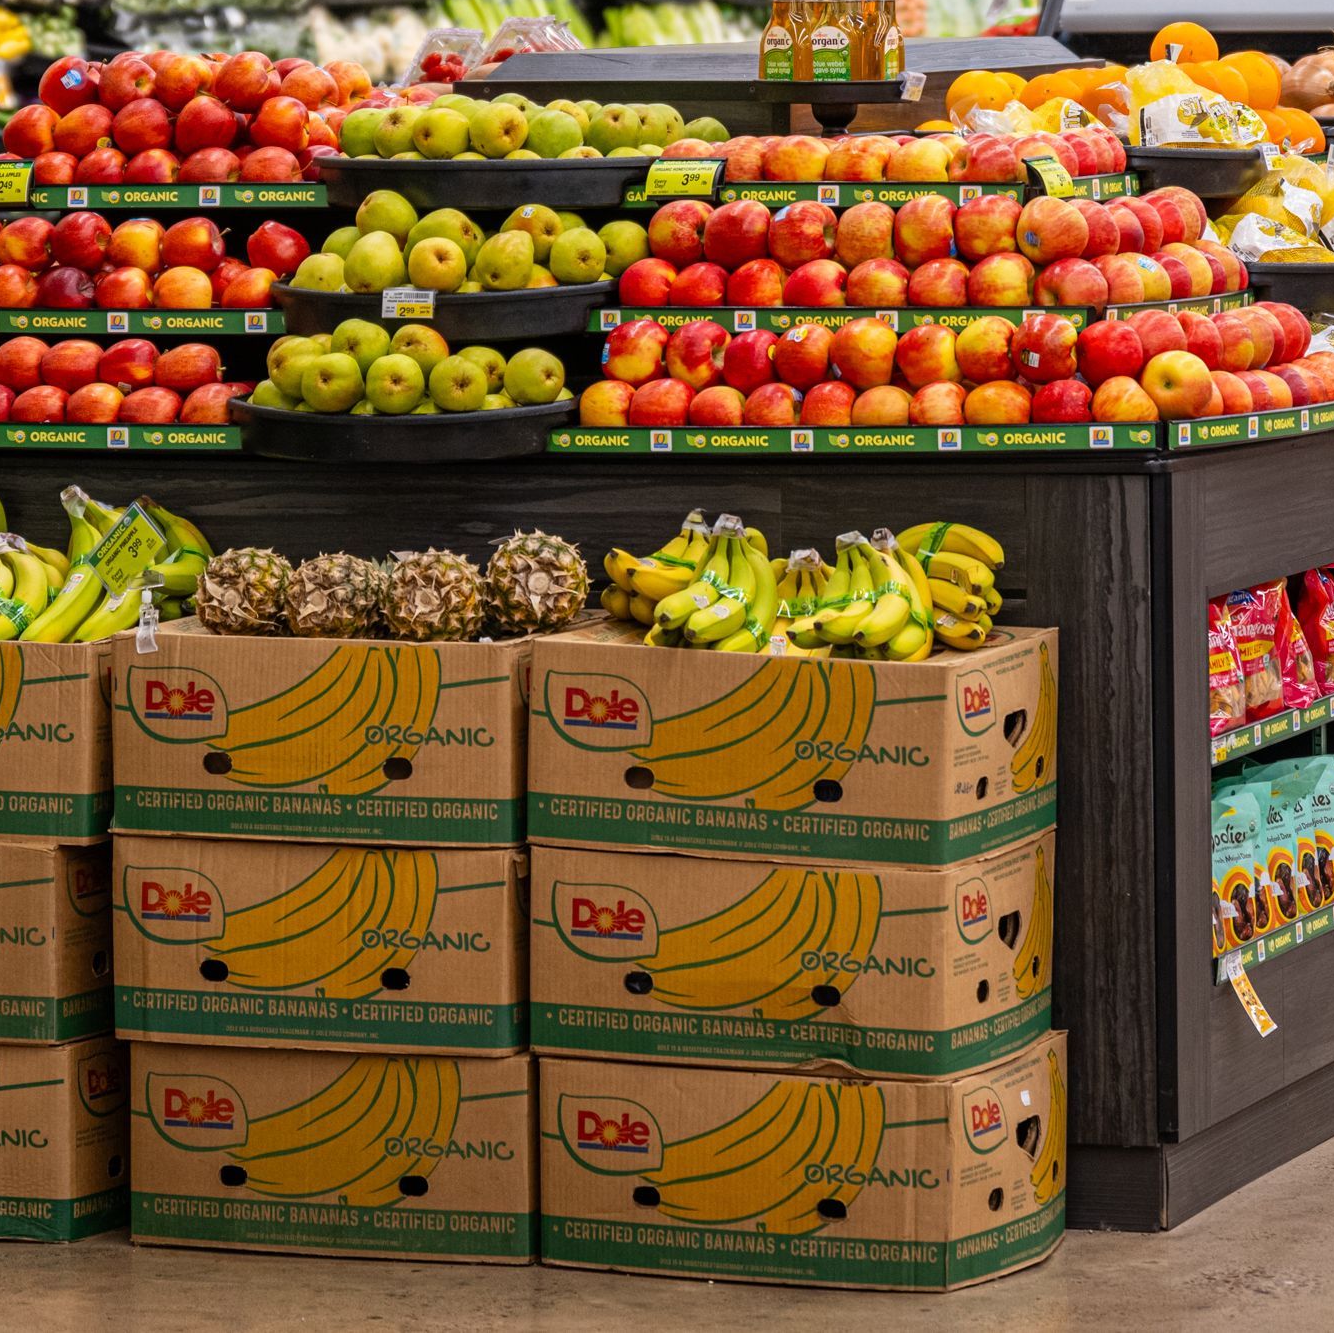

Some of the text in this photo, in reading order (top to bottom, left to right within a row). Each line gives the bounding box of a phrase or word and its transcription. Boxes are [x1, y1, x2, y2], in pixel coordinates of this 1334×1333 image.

[124, 191, 315, 202] ORGANIC ORGANIC
[740, 190, 938, 201] ORGANIC ORGAN
[32, 316, 86, 328] ORGANIC
[166, 317, 223, 328] ORGANIC
[657, 315, 852, 327] ORGANIC ORGANIC
[30, 432, 86, 443] ORGANIC
[168, 432, 226, 444] ORGANIC
[575, 432, 1066, 446] ORGANIC ORGANIC ORGANIC ORGANIC
[1210, 424, 1240, 437] ORGANIC
[1273, 416, 1295, 430] ORGANIC
[96, 523, 127, 560] ORGANIC
[144, 680, 216, 716] Dole
[564, 686, 640, 723] Dole
[963, 682, 992, 713] Dole
[364, 725, 495, 747] ORGANIC
[794, 741, 930, 766] ORGANIC
[9, 796, 74, 815] ORGANIC
[137, 791, 498, 821] CERTIFIED ORGANIC BANANAS CERTIFIED ORGANIC
[551, 798, 930, 842] CERTIFIED ORGANIC BANANAS CERTIFIED ORGANIC
[948, 804, 1015, 841] BANANAS CERTIFIED
[142, 881, 213, 916] Dole
[961, 890, 988, 921] Dole
[571, 897, 647, 933] Dole
[361, 928, 491, 952] ORGANIC
[1274, 932, 1291, 948] ORGANIC
[800, 950, 936, 979] ORGANIC
[133, 991, 493, 1026] CERTIFIED ORGANIC BANANAS CERTIFIED ORGANIC
[558, 1008, 936, 1053] CERTIFIED ORGANIC BANANAS CERTIFIED ORGANIC
[951, 1025, 989, 1050] BANANAS
[993, 1011, 1020, 1037] CERTIFIED
[164, 1088, 235, 1123] Dole
[971, 1098, 1001, 1131] Dole
[577, 1109, 651, 1146] Dole
[384, 1137, 515, 1161] ORGANIC
[804, 1164, 941, 1189] ORGANIC
[154, 1198, 516, 1234] CERTIFIED ORGANIC BANANAS CERTIFIED ORGANIC
[565, 1221, 939, 1265] CERTIFIED ORGANIC BANANAS CERTIFIED ORGANIC
[956, 1214, 1041, 1261] BANANAS CERTIFIED
